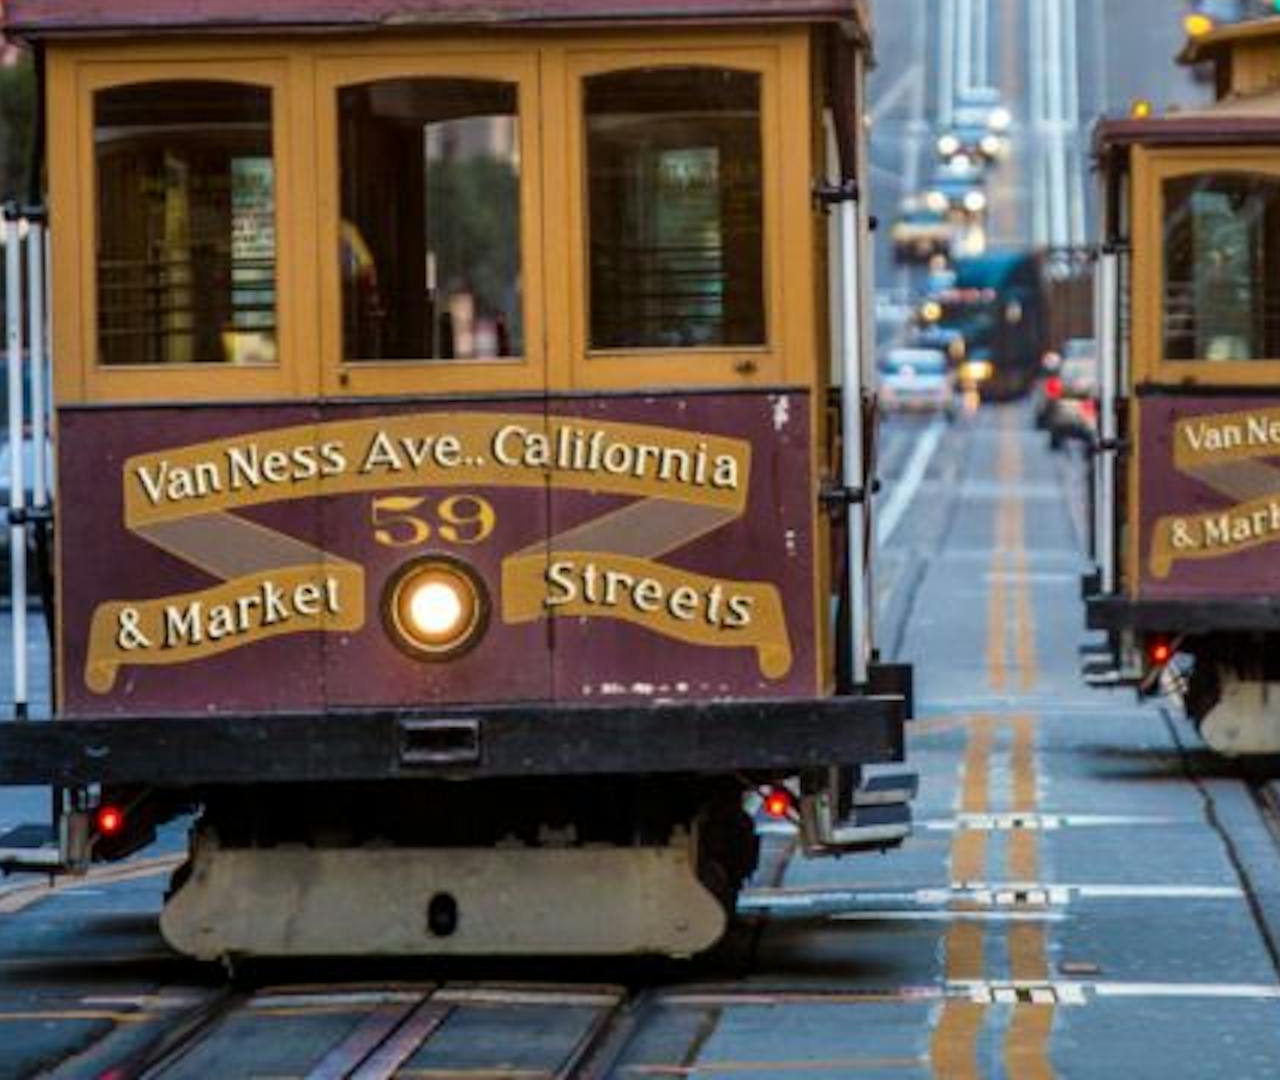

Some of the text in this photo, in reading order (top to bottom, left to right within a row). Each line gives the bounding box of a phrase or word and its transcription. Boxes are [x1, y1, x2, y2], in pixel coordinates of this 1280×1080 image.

[135, 460, 220, 505] Van
[225, 440, 346, 490] Ness
[492, 424, 740, 490] California
[1184, 422, 1241, 451] Van
[370, 493, 497, 548] 59
[1171, 519, 1195, 549] &
[116, 576, 343, 652] & Market
[542, 561, 757, 628] Streets
